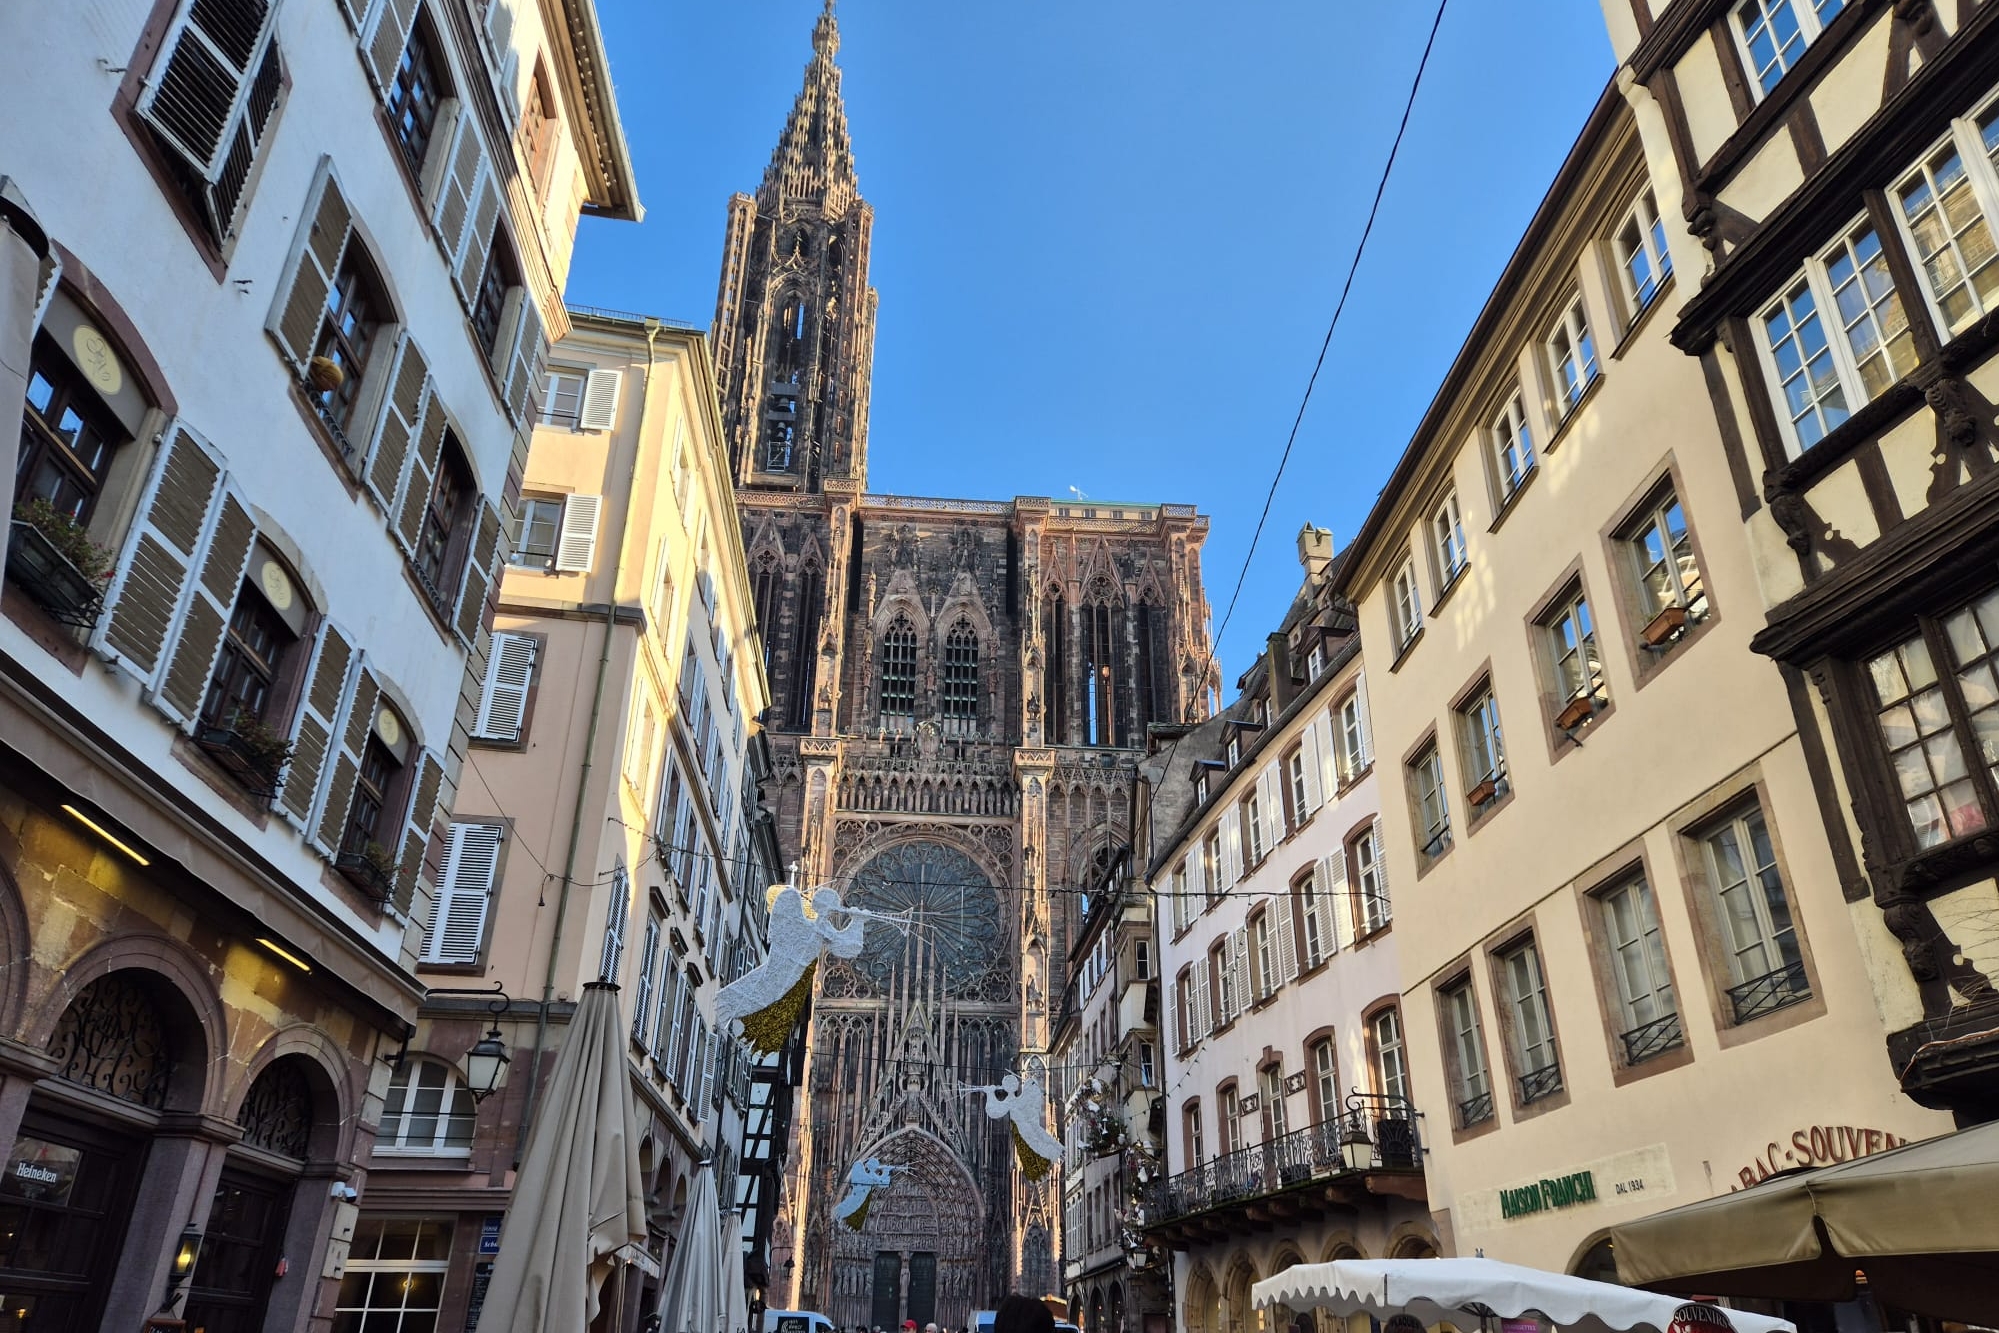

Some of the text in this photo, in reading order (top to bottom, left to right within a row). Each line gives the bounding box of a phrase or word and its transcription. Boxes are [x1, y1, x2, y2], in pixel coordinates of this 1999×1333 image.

[16, 1162, 57, 1183] Heineken
[1499, 1170, 1597, 1220] MAISON FRANCHI
[1615, 1178, 1645, 1195] DAL 1934
[1674, 1305, 1729, 1328] SOUVENIRS
